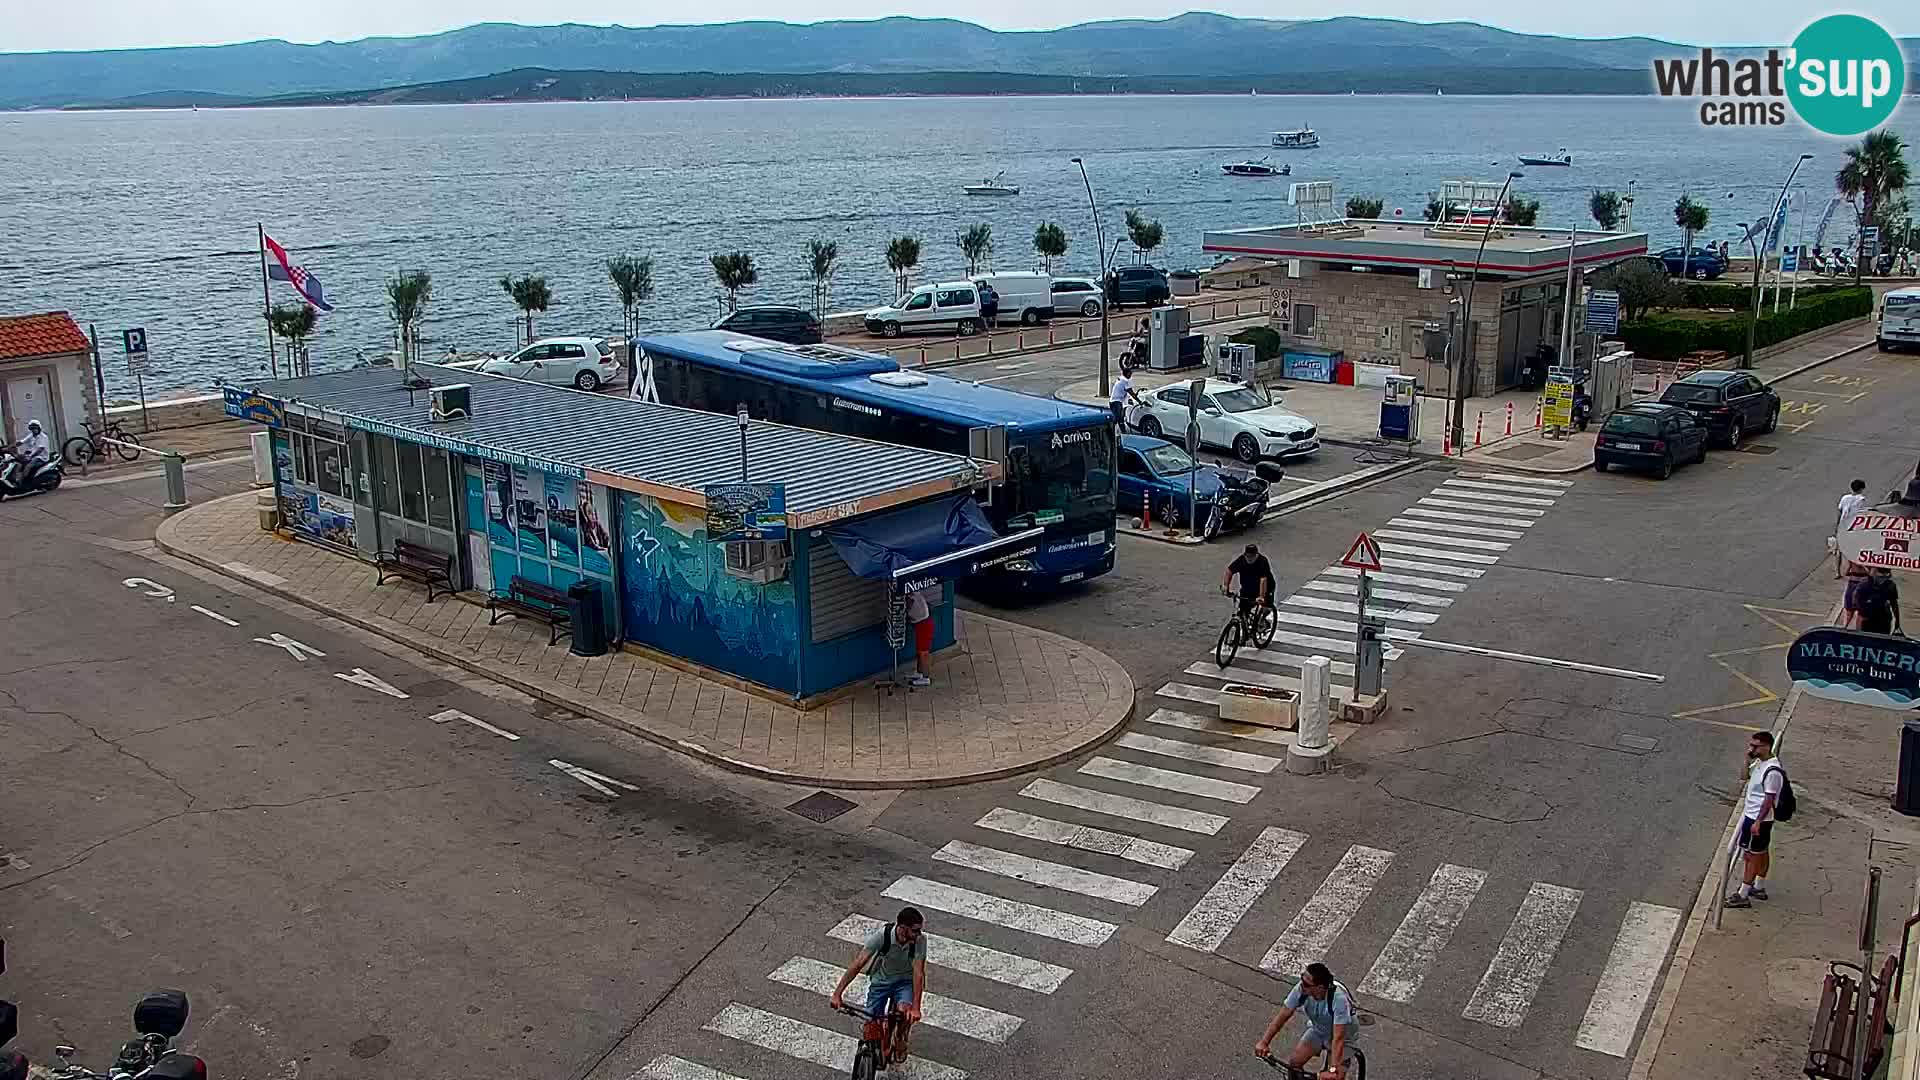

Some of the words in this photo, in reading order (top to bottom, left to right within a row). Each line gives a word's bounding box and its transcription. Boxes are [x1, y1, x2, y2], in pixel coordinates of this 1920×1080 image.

[128, 332, 141, 350] P
[1063, 431, 1091, 443] arriva
[436, 437, 467, 453] POSTAJA
[477, 446, 492, 459] BUS
[493, 450, 525, 466] STATION
[527, 457, 552, 472] TICKET
[553, 463, 582, 479] OFFICE
[1828, 662, 1865, 675] caffe
[1869, 665, 1896, 681] bar
